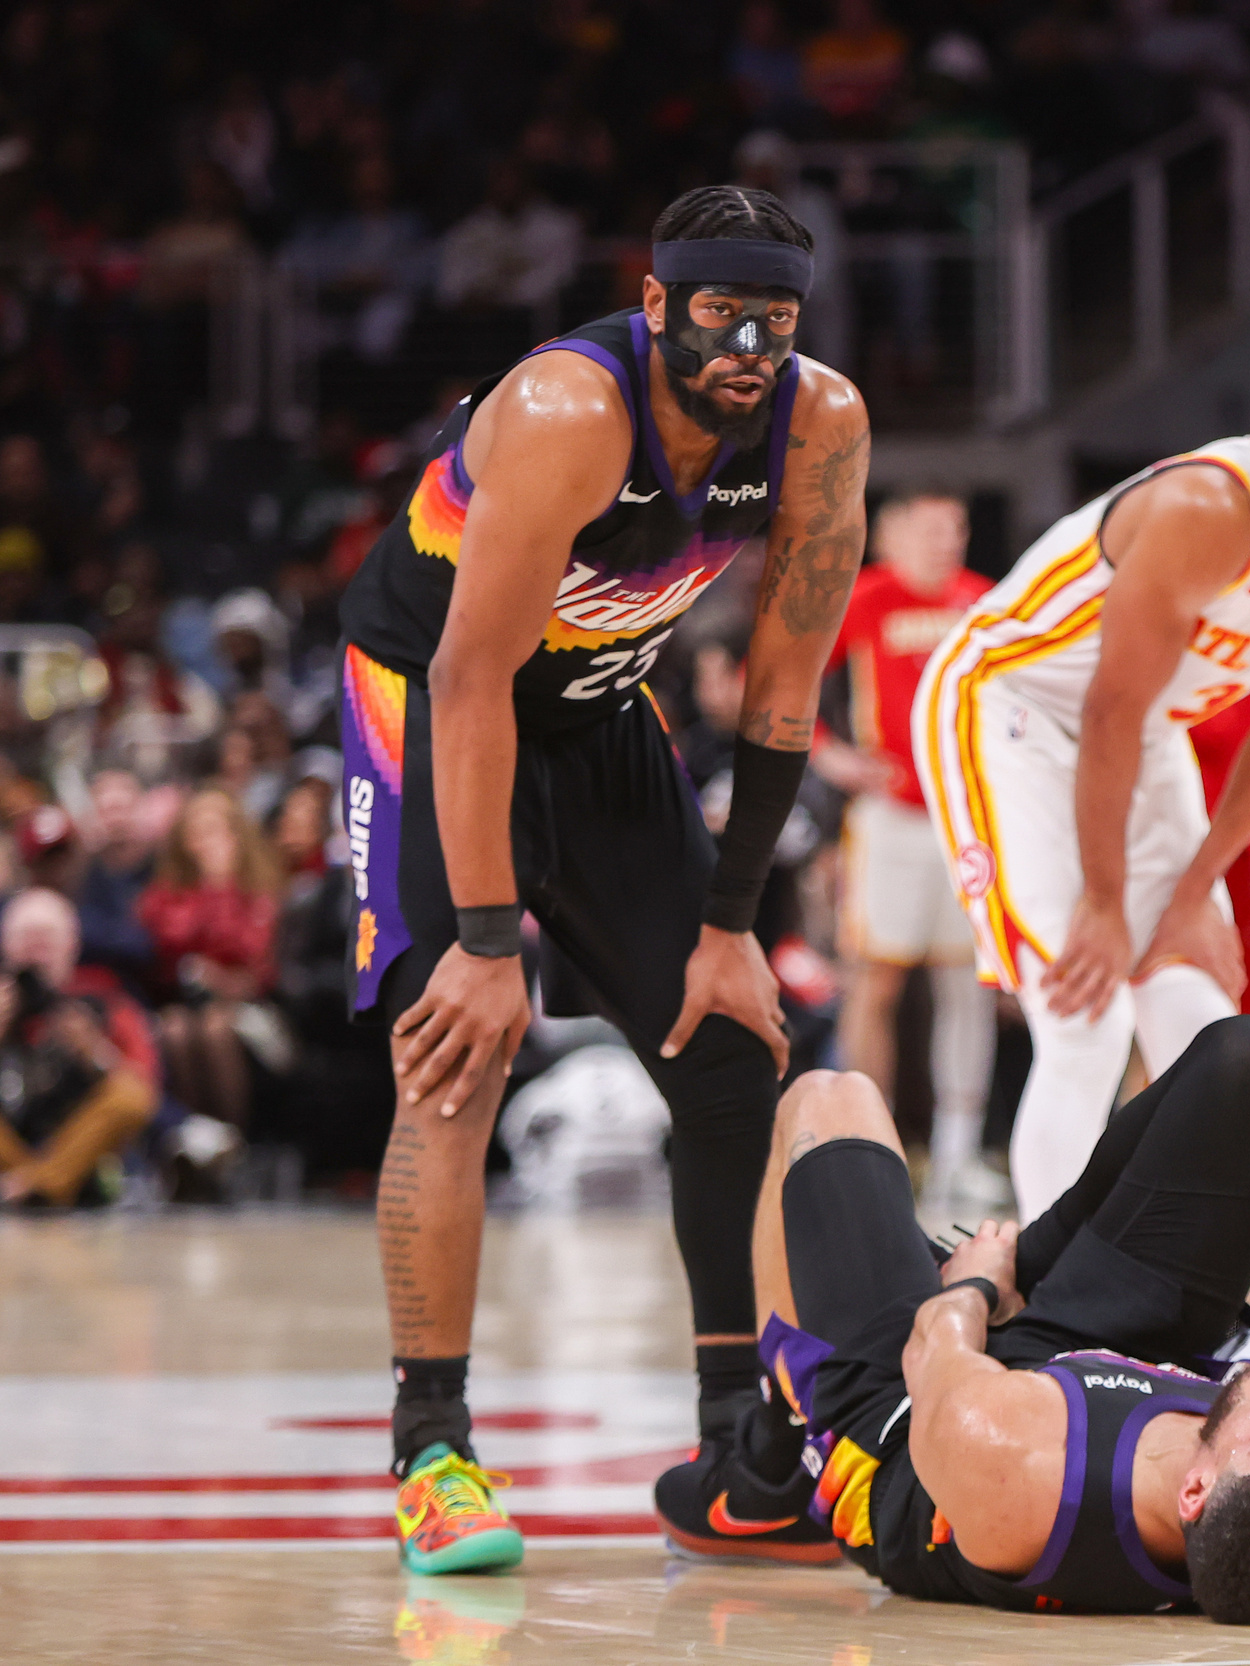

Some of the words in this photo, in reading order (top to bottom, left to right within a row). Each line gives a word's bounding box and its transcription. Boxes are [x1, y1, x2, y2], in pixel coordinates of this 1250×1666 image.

[707, 481, 768, 507] PayPal
[611, 588, 657, 602] THE
[1083, 1373, 1153, 1395] PayPal
